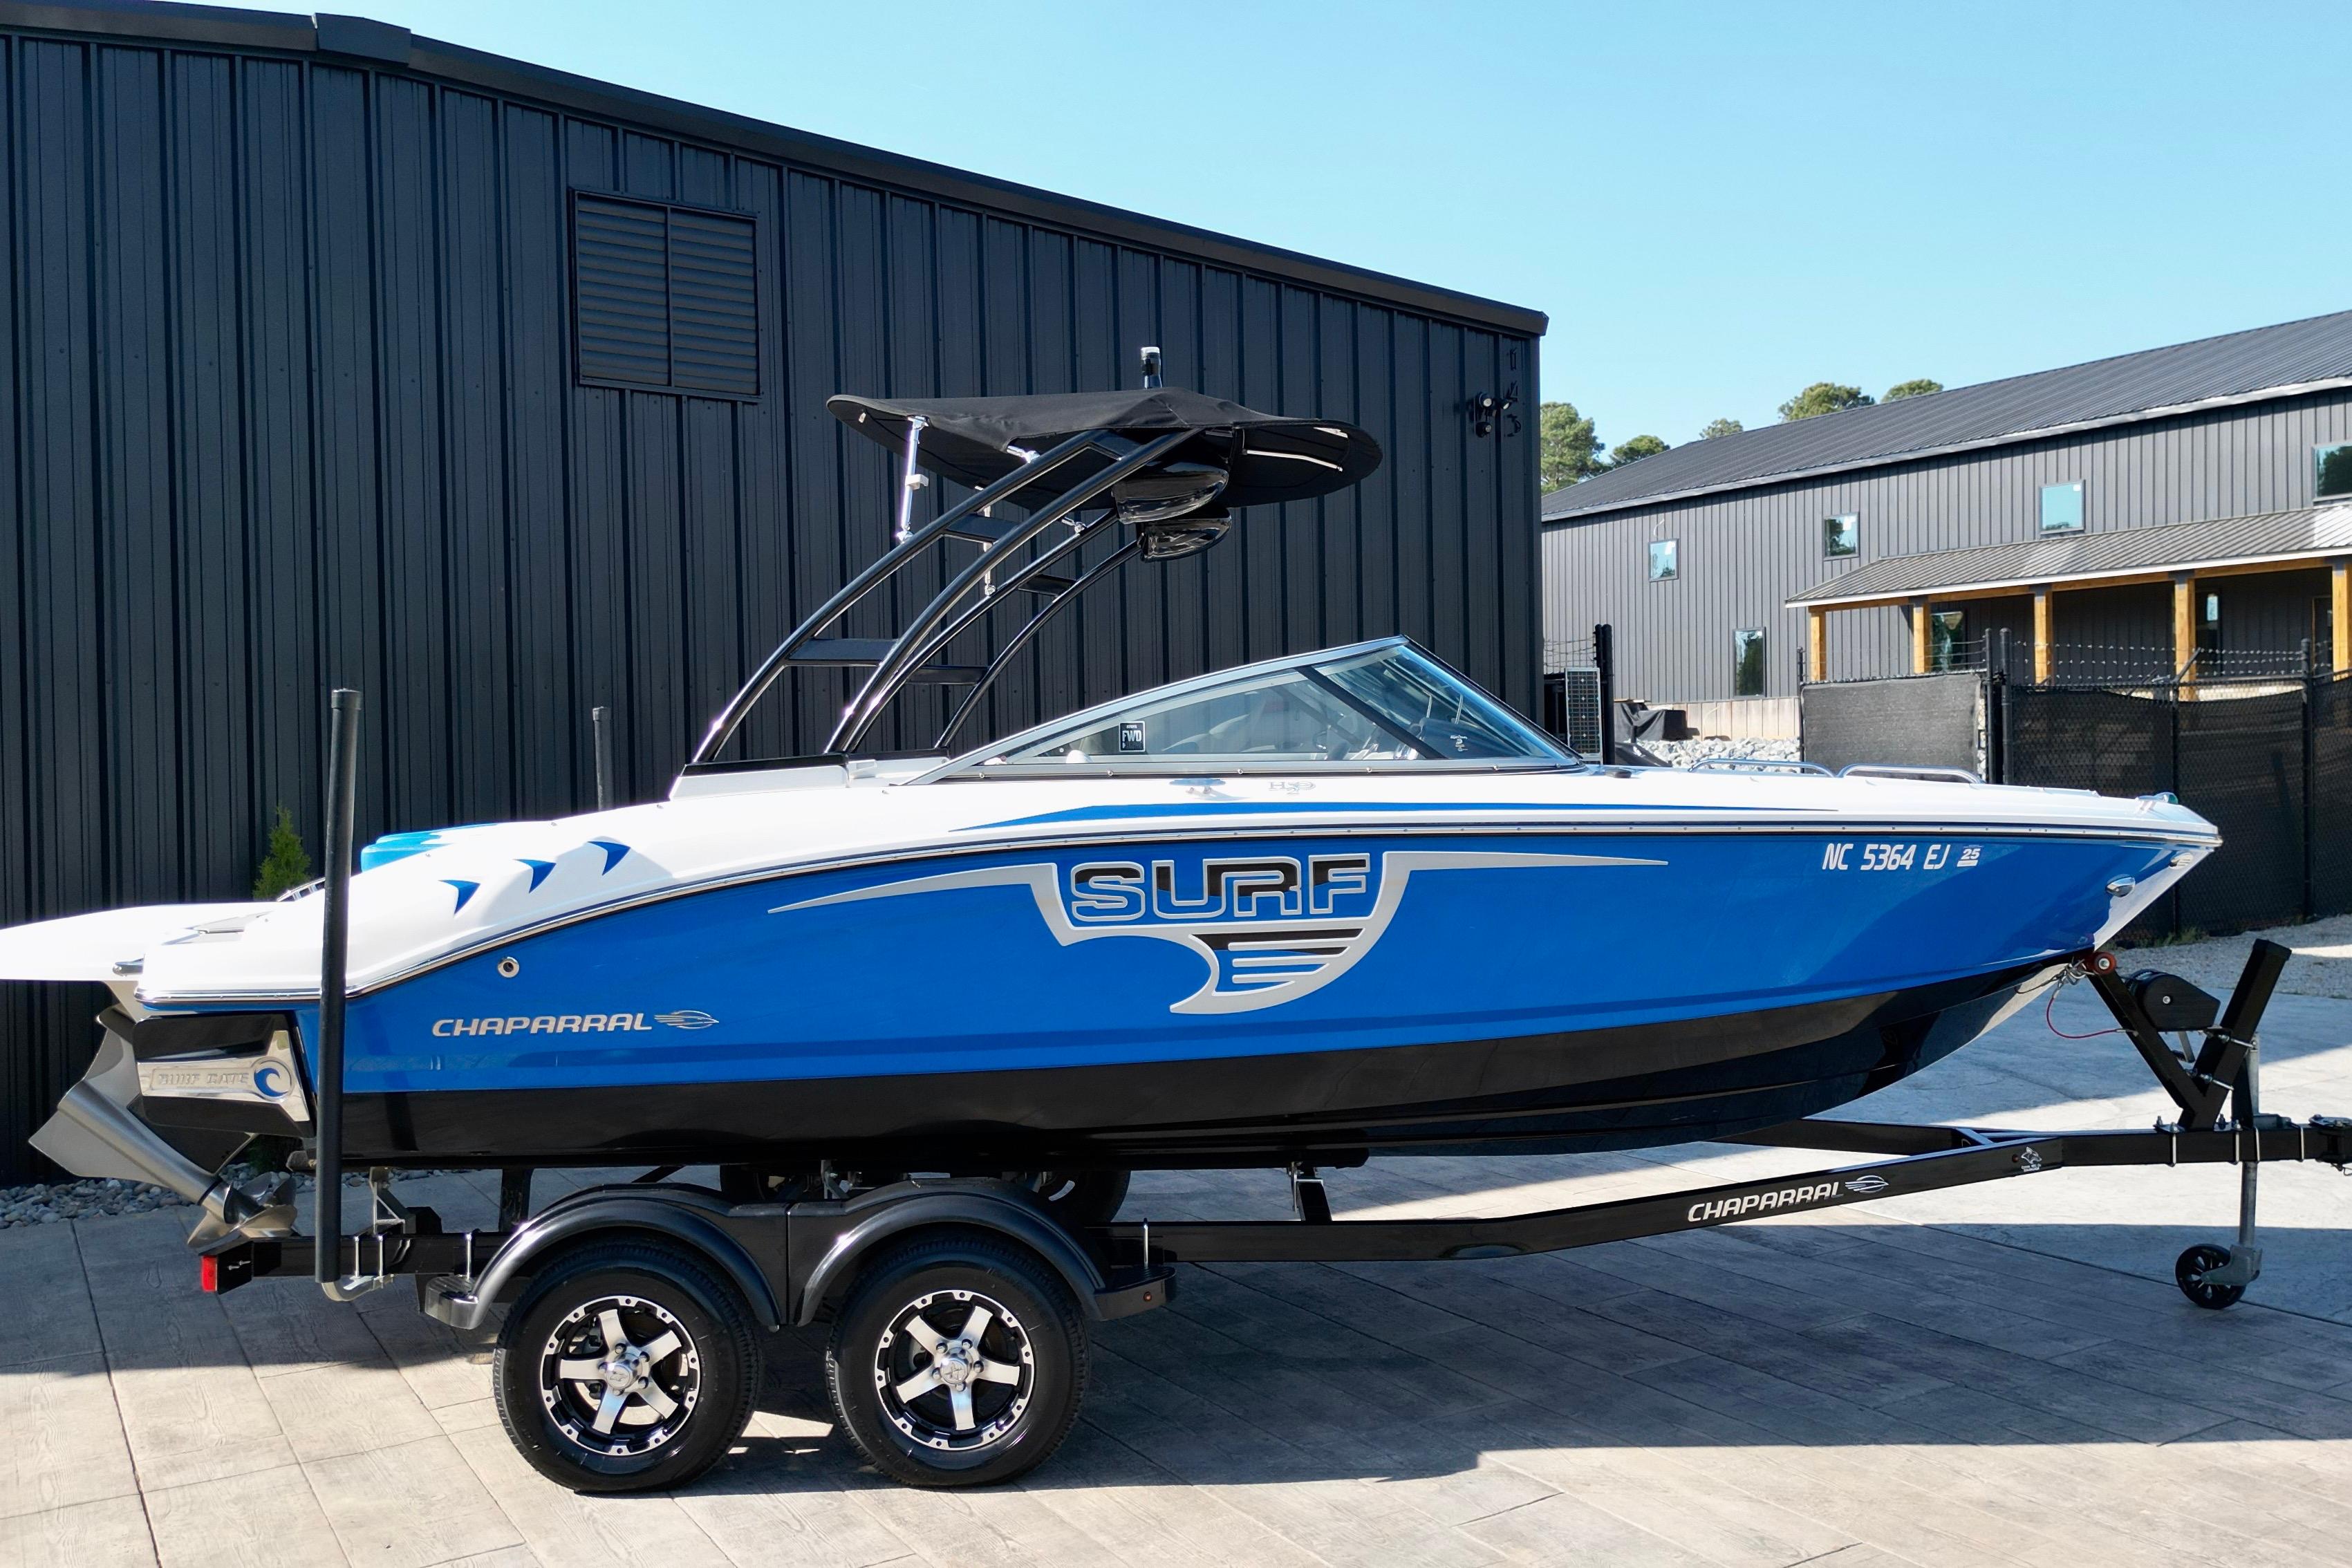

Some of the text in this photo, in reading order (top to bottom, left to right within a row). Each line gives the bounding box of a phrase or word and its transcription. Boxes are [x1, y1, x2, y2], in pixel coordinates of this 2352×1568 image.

[1122, 729, 1142, 742] FWD
[1822, 843, 1951, 870] NC 5364 EJ
[1960, 848, 1981, 860] 25
[1070, 852, 1371, 922] SURF
[431, 1013, 653, 1037] CHAPARRAL
[1687, 1182, 1844, 1222] CHAPARRAL
